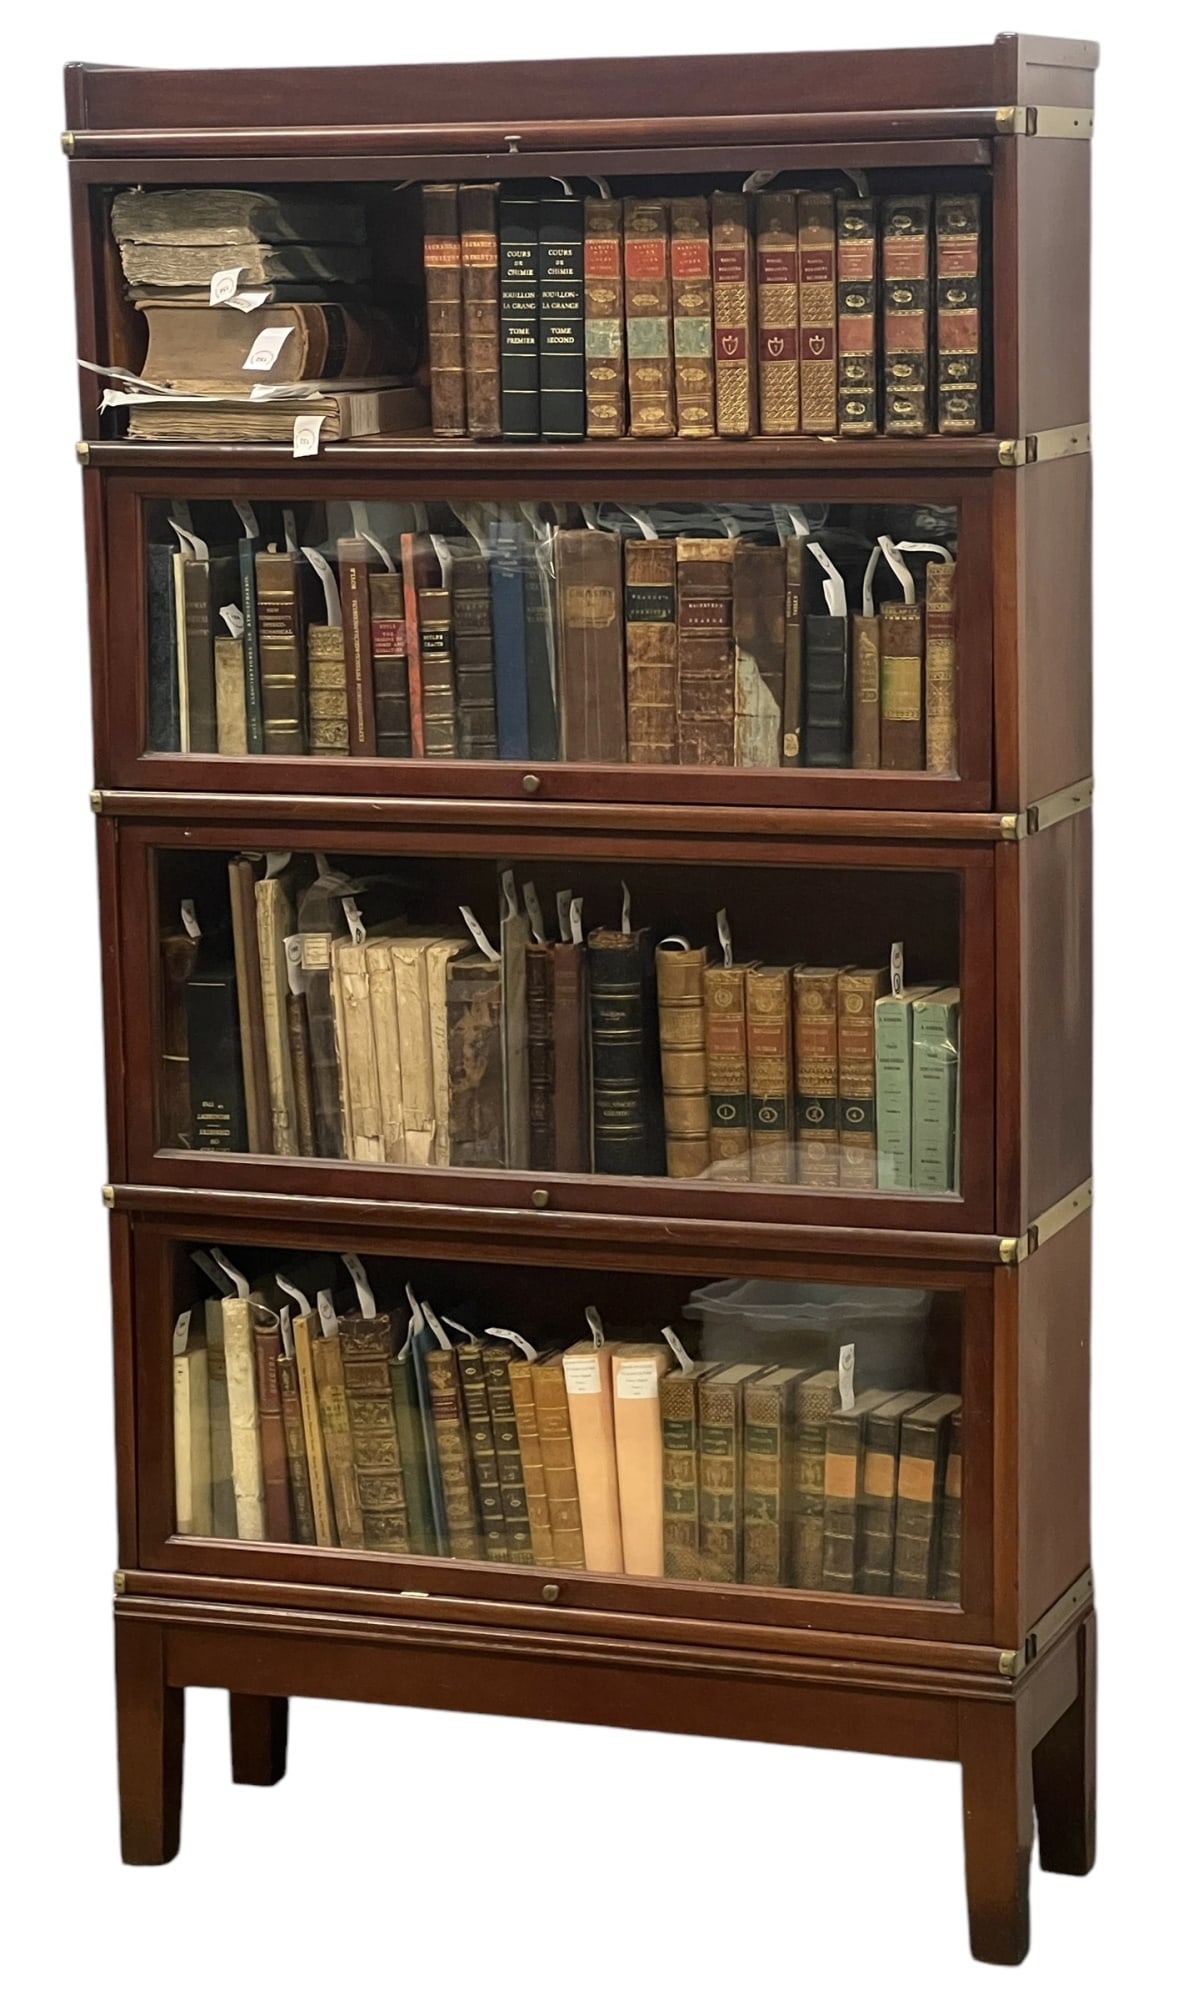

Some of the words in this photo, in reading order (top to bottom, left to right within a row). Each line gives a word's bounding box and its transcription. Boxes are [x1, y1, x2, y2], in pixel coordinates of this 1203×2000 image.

[506, 250, 532, 258] COURS
[502, 302, 511, 310] LA
[508, 327, 530, 335] TOME
[550, 327, 572, 335] TOME
[506, 337, 536, 345] PREMIER
